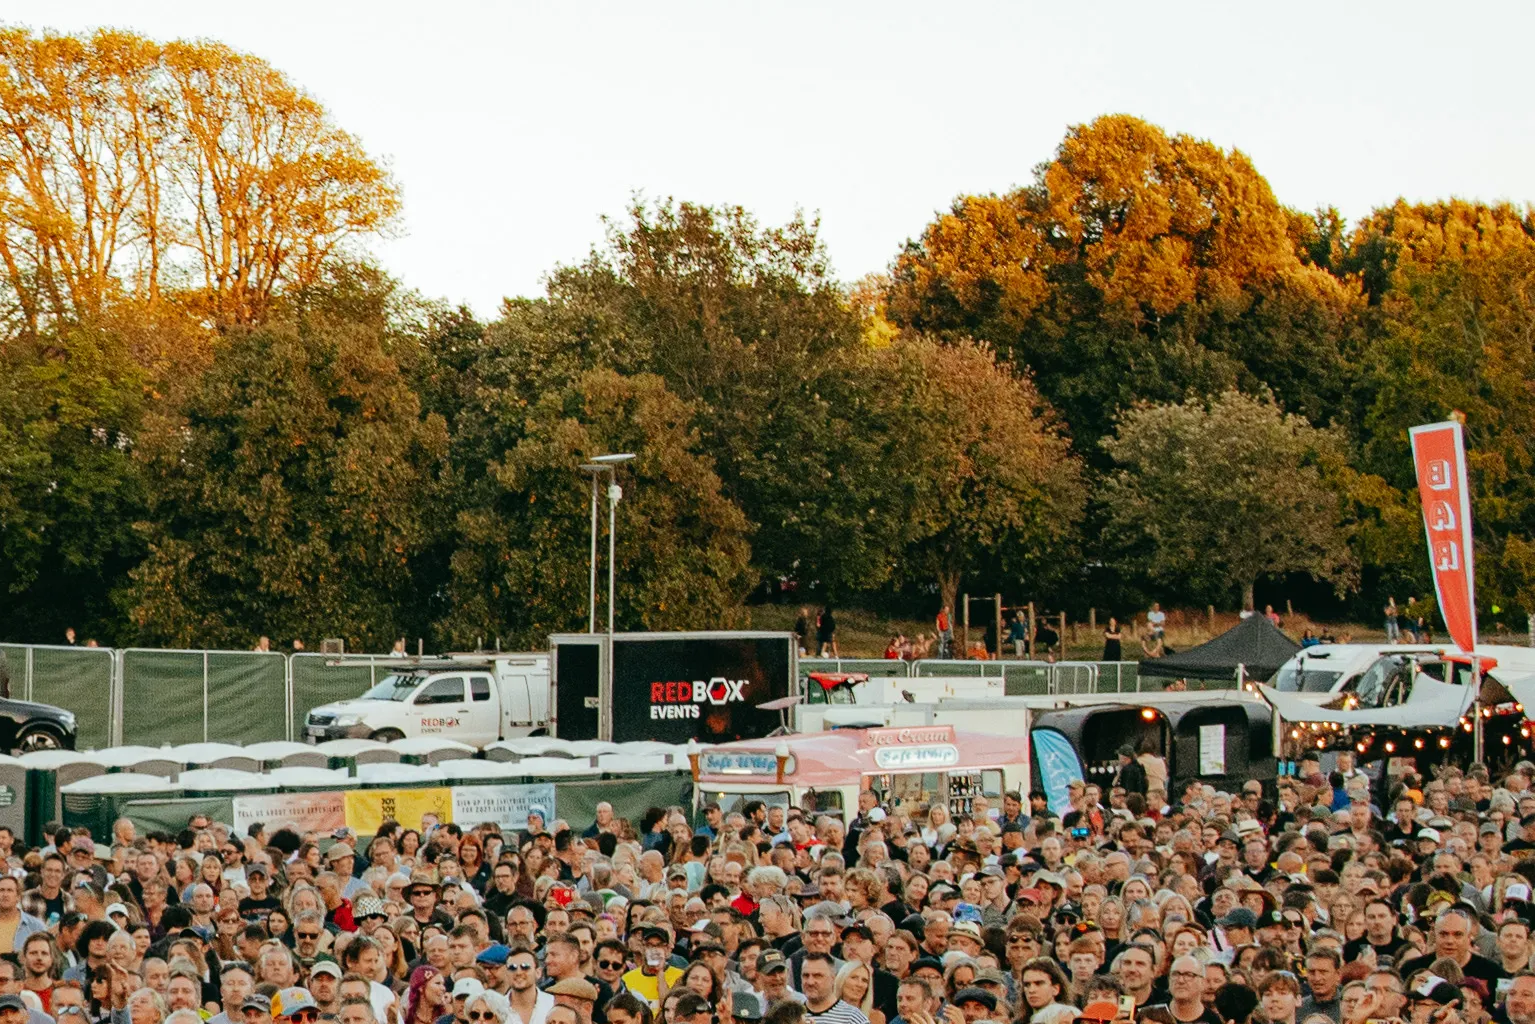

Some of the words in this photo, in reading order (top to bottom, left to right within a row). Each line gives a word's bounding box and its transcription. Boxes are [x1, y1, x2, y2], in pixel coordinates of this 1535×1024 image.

[650, 704, 700, 719] EVENTS
[866, 732, 893, 746] Ice
[897, 728, 949, 744] Cream
